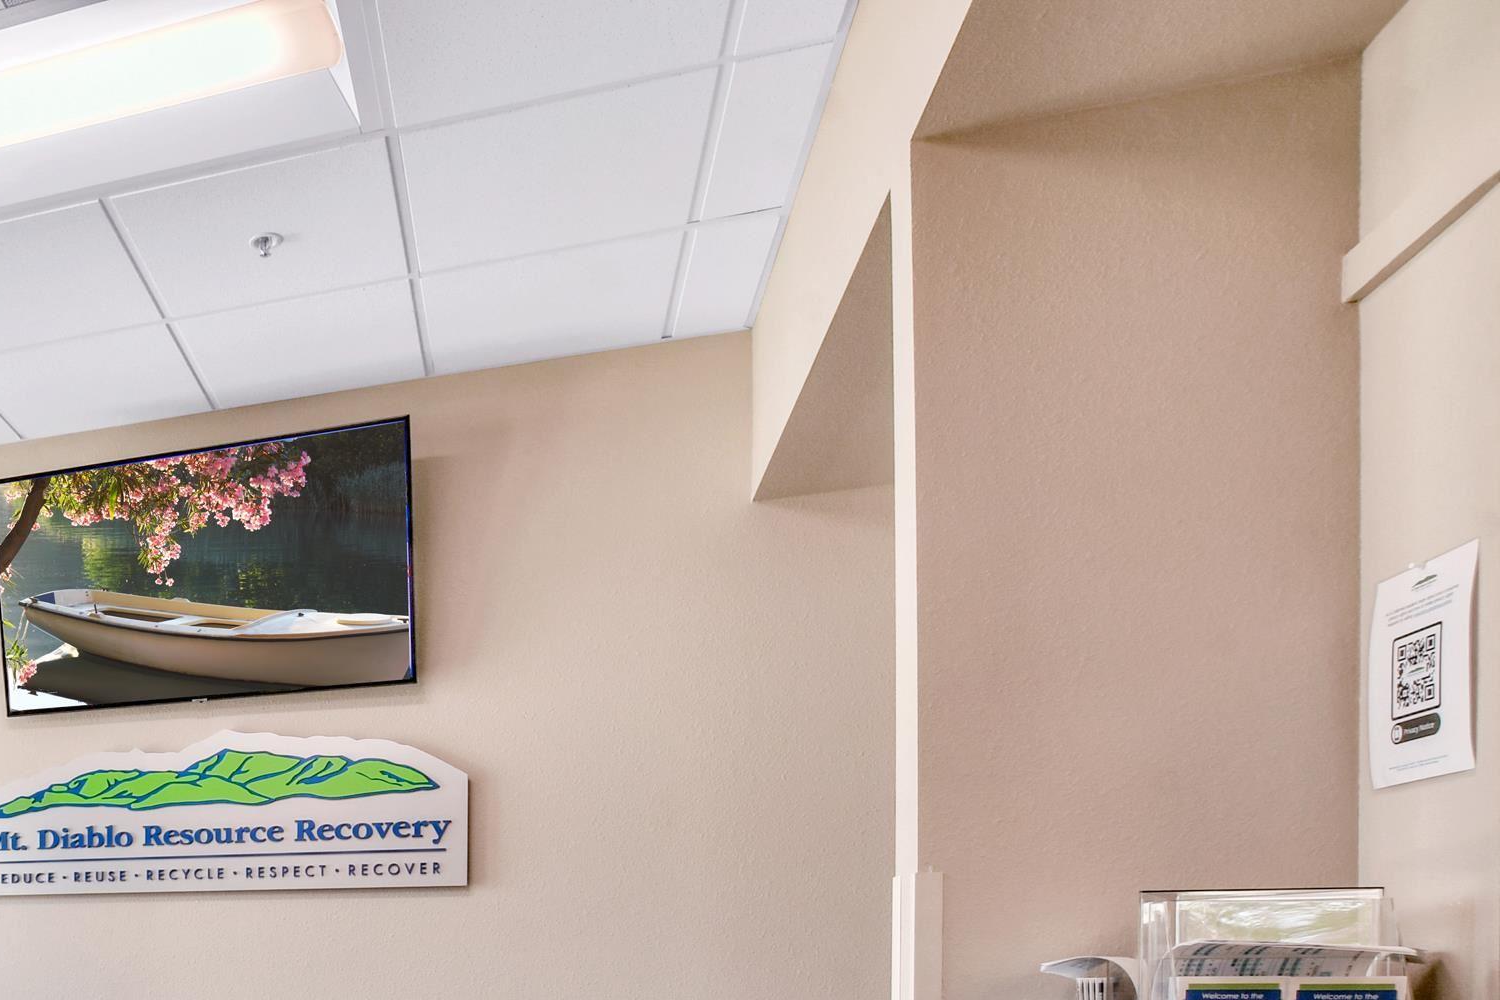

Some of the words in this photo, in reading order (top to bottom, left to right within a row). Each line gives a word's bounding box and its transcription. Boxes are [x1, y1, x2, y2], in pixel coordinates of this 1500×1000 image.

[37, 824, 134, 850] Diablo
[143, 824, 284, 847] Resource
[294, 819, 452, 845] Recovery
[74, 870, 128, 883] REUSE
[146, 868, 225, 881] RECYCLE
[246, 864, 327, 879] RESPECT
[348, 862, 442, 876] RECOVER
[1201, 992, 1239, 1000] Welcome
[1240, 992, 1250, 1000] to
[1250, 992, 1264, 1000] the
[1313, 993, 1352, 1000] Welcome
[1354, 993, 1363, 1000] to
[1364, 993, 1379, 1000] the
